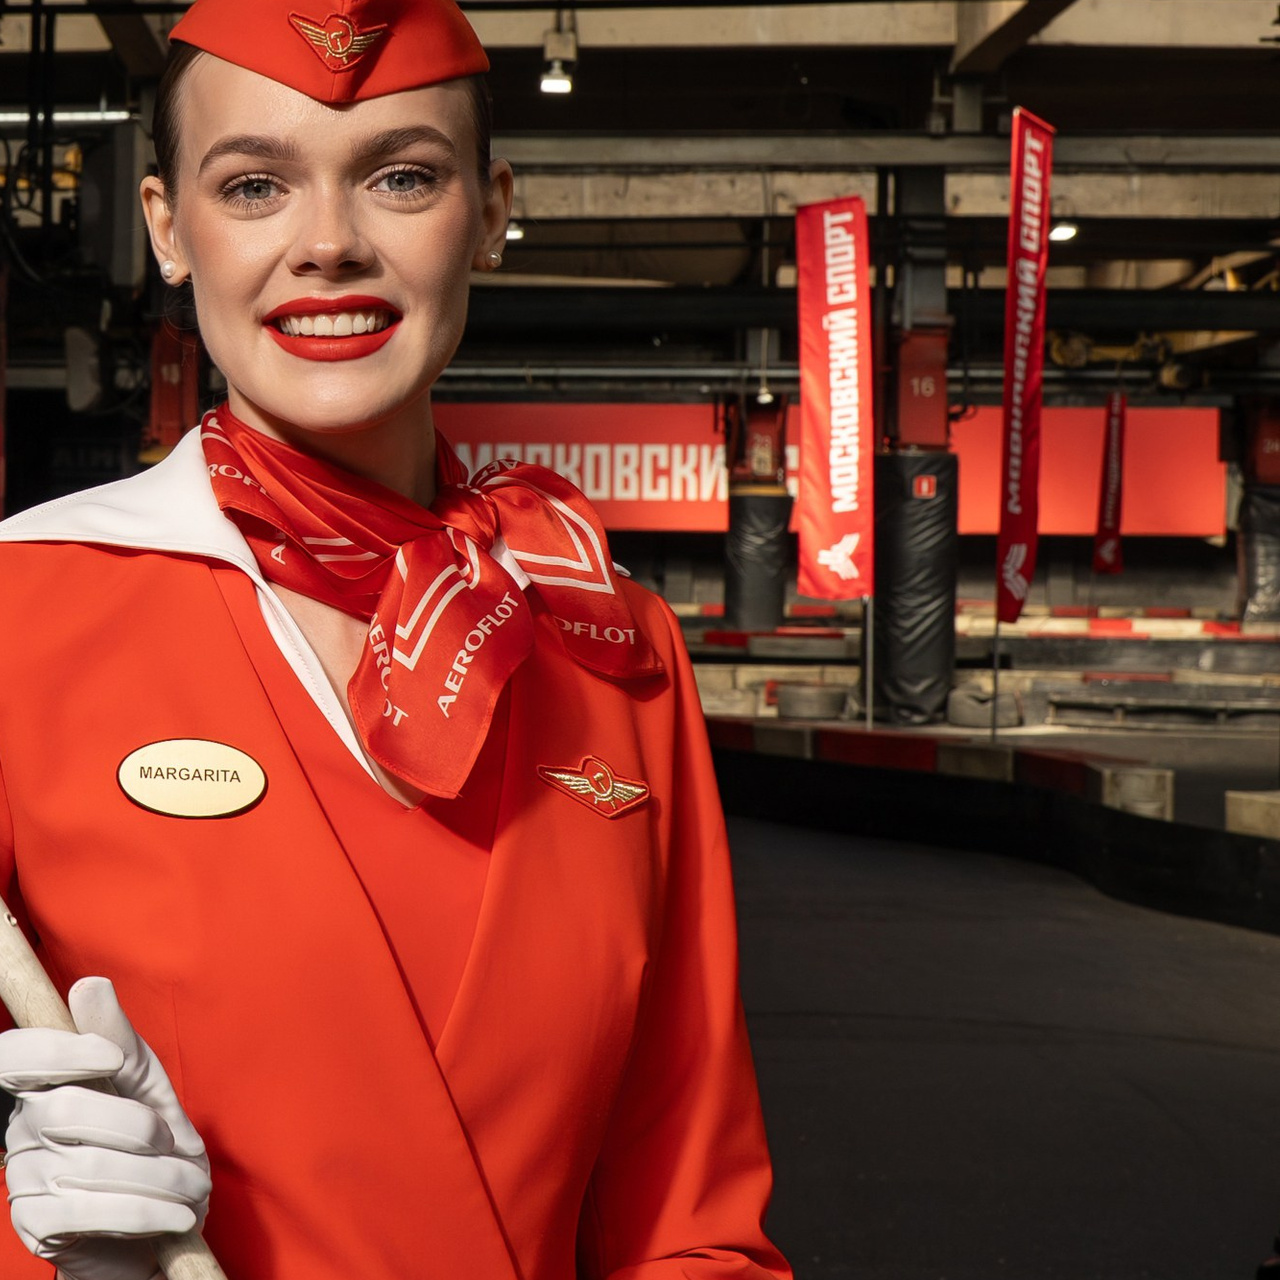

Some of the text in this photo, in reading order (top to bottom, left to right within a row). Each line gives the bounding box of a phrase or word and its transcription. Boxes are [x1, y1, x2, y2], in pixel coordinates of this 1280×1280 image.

[1020, 127, 1046, 254] СПОРТ
[822, 210, 860, 513] МОСКОВСКИЙ СПОРТ
[910, 376, 936, 398] 16
[436, 591, 520, 719] AEROFLOT
[139, 766, 242, 784] MARGARITA
